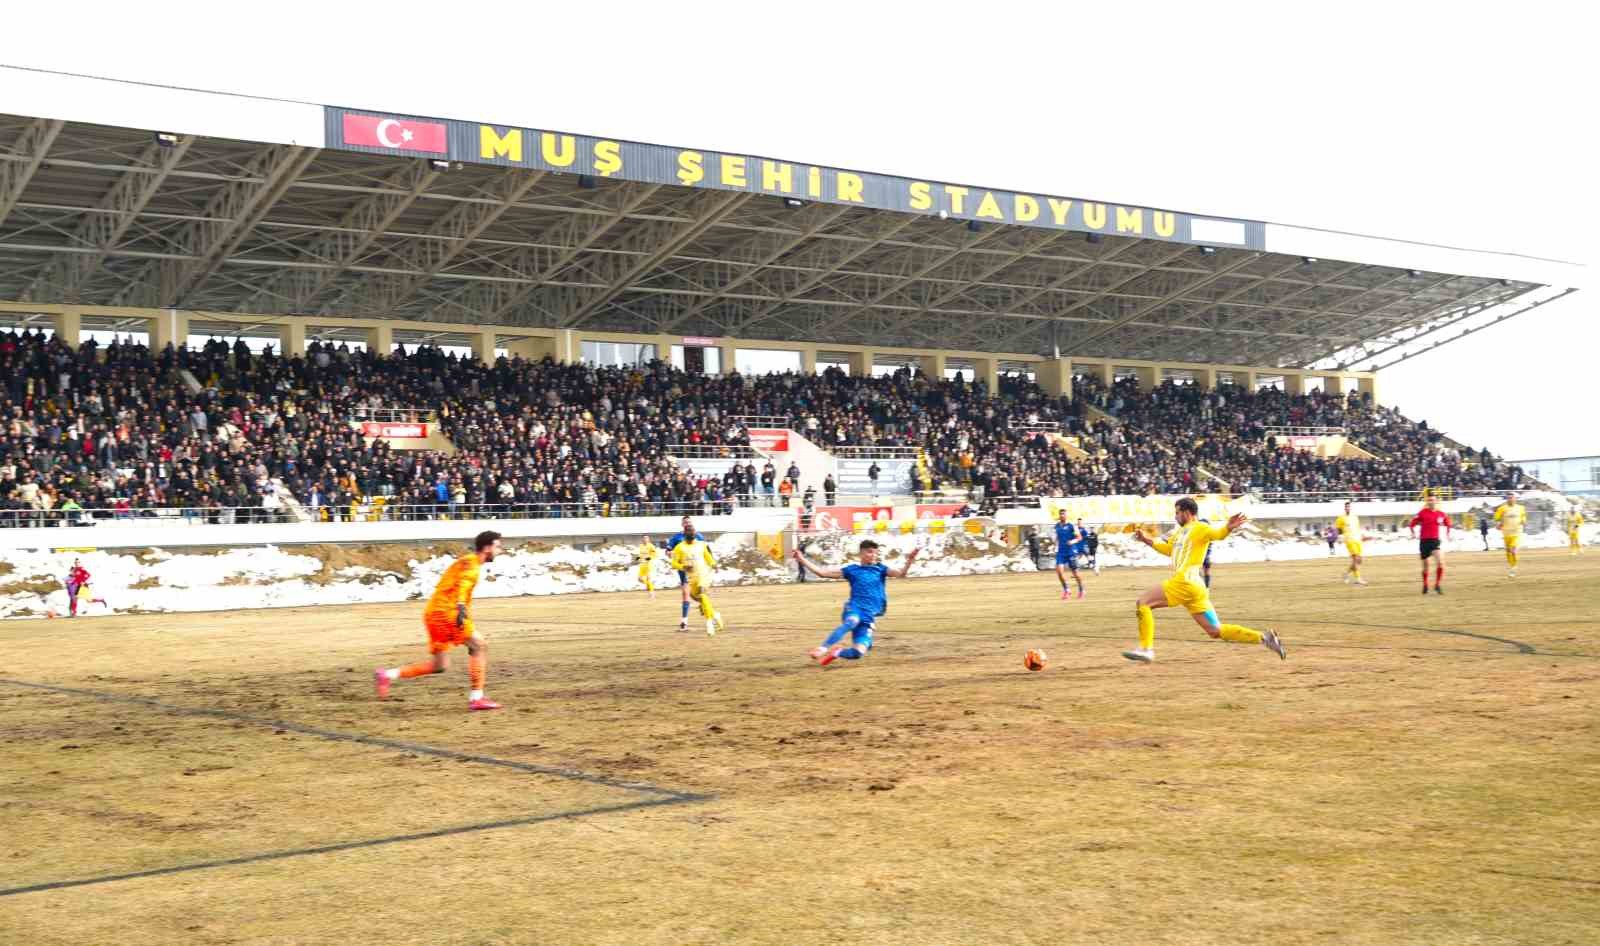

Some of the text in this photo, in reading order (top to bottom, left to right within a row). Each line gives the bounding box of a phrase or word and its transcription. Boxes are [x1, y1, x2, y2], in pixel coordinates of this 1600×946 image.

[480, 127, 1176, 236] MUŞ ŞEHİR STADYUMU
